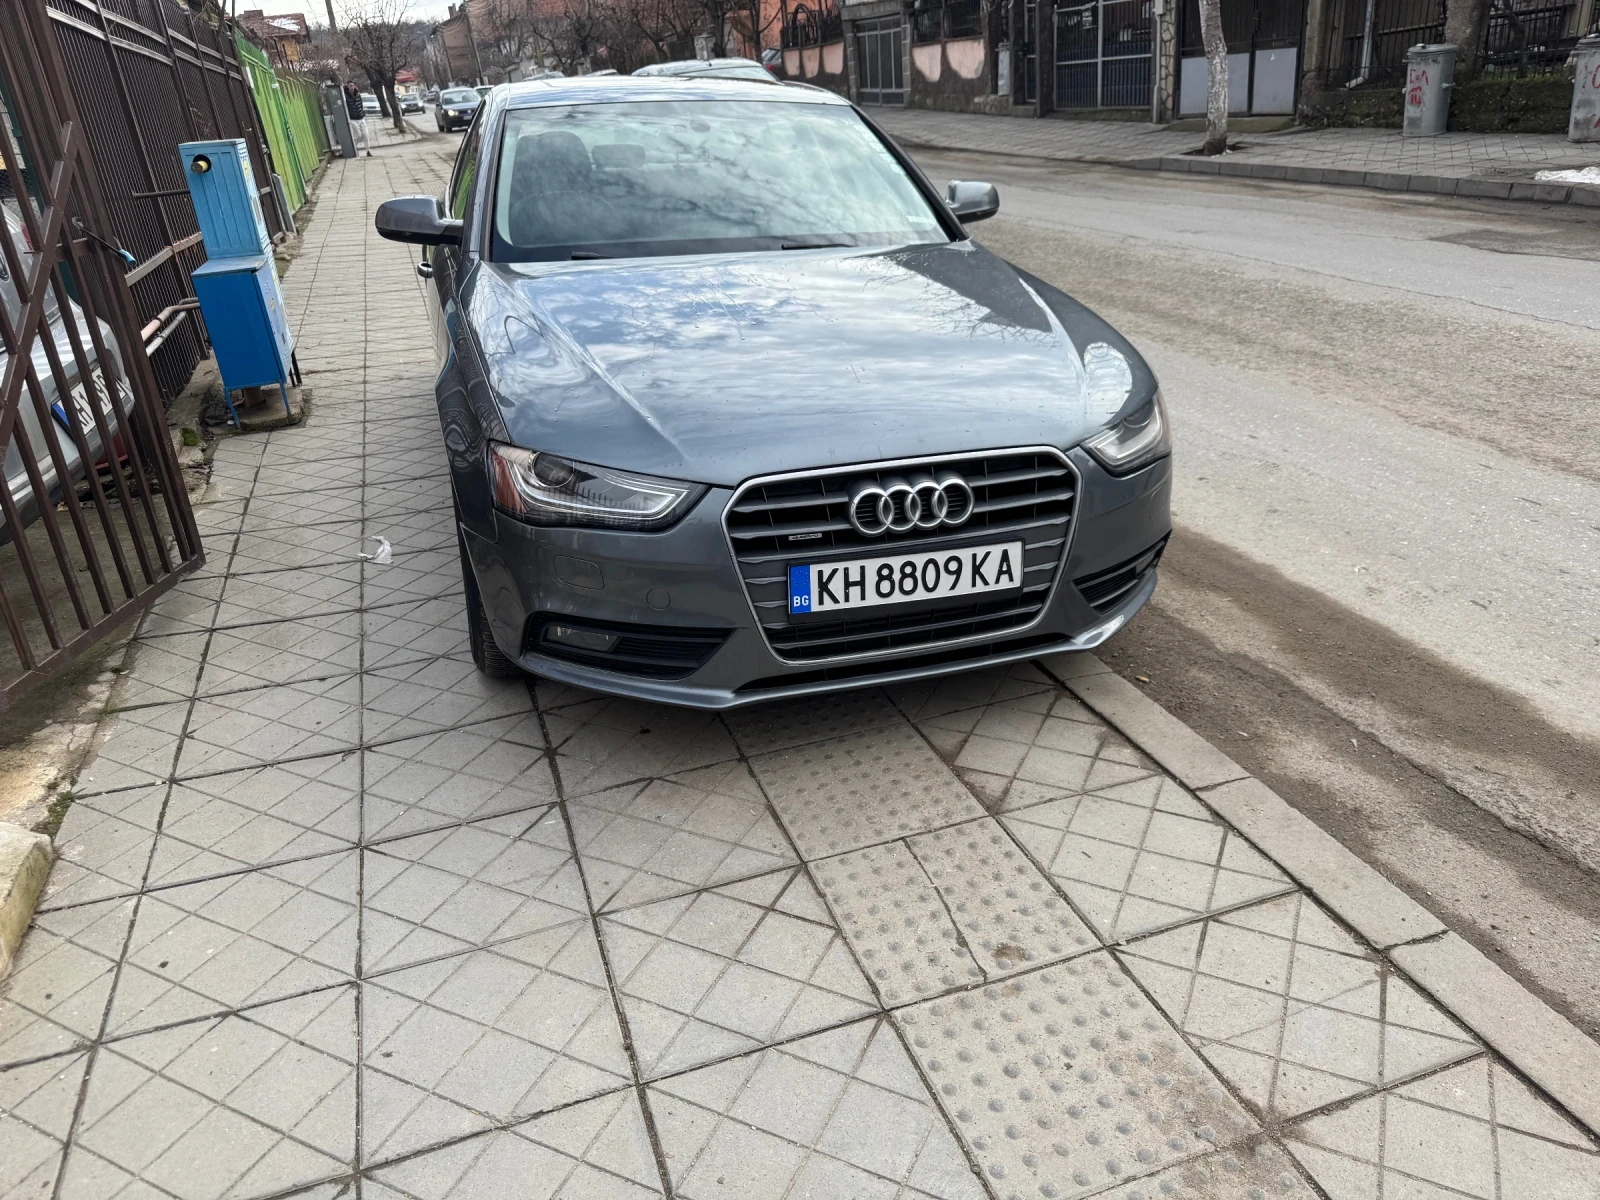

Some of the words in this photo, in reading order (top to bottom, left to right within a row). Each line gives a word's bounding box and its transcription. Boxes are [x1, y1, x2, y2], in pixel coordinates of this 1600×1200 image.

[875, 555, 963, 599] 8809
[971, 548, 1014, 588] KA
[793, 595, 809, 607] BG
